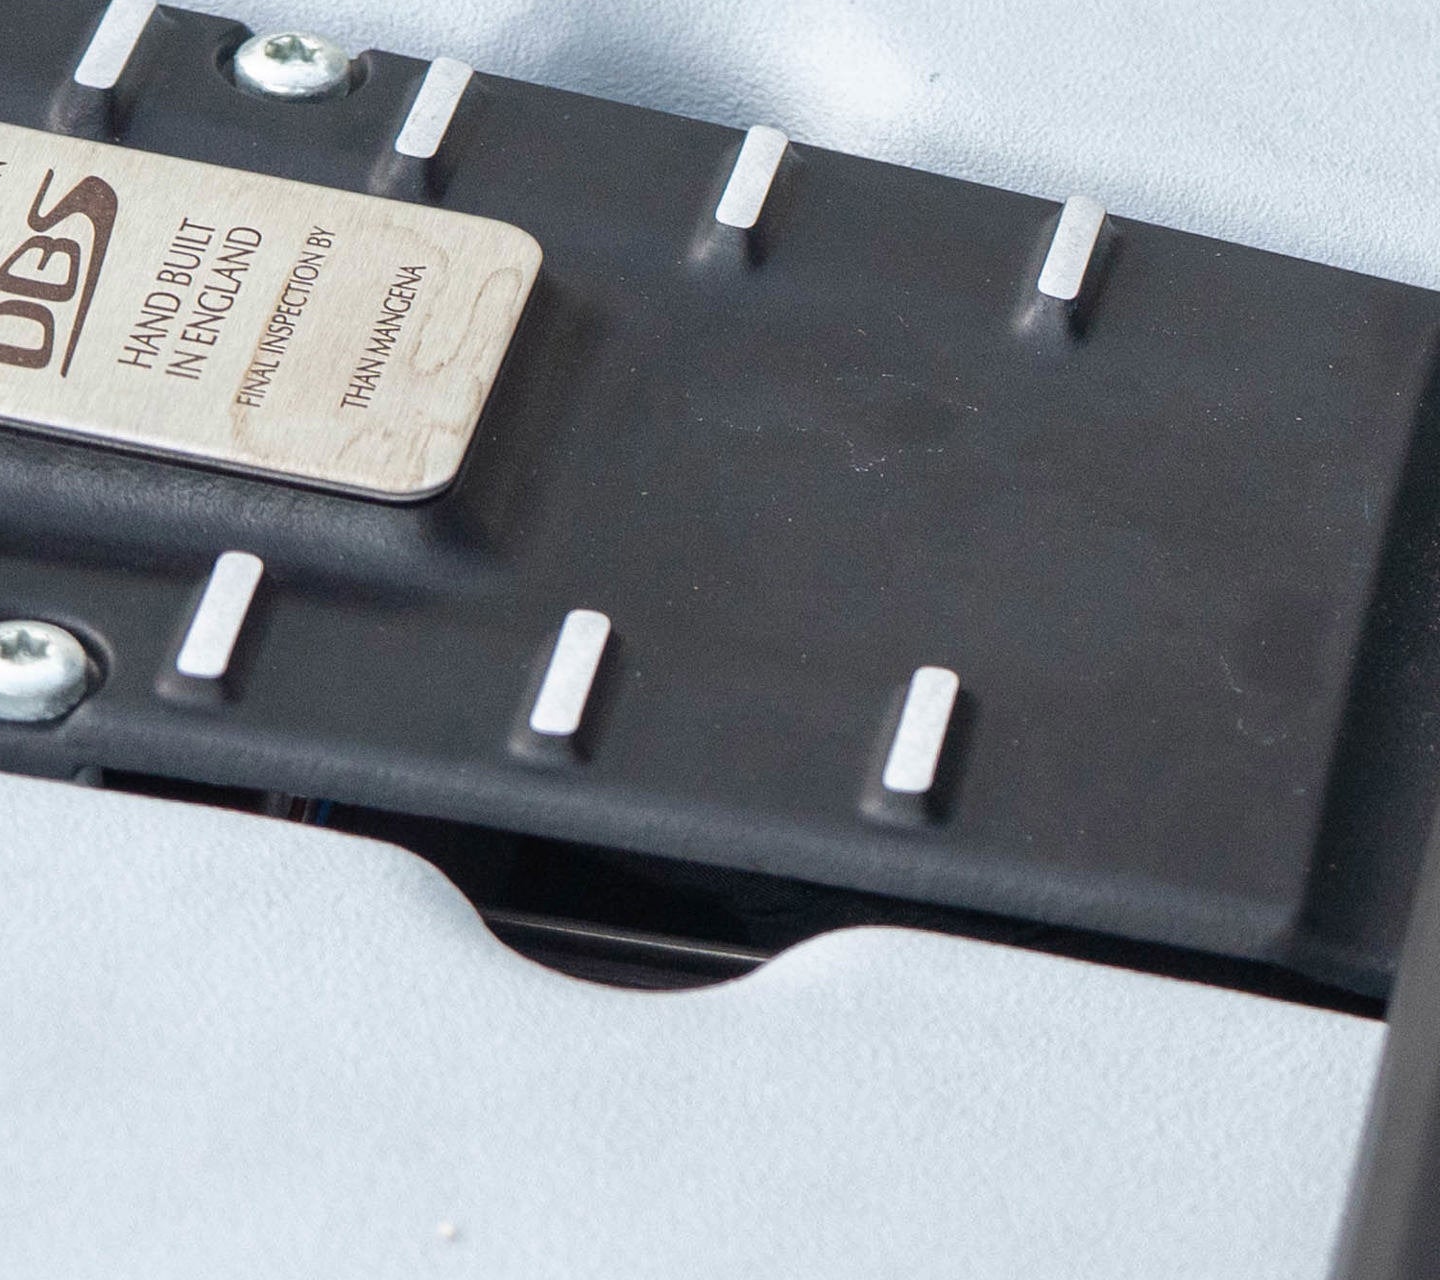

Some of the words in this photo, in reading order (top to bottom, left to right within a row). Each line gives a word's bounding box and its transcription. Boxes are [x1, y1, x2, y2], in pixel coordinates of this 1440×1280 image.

[117, 291, 181, 369] HAND
[156, 217, 216, 287] BUILT
[180, 226, 263, 346] ENGLAND
[236, 360, 280, 408] FINAL
[259, 250, 326, 355] INSPECTION
[306, 225, 336, 249] BY
[340, 357, 386, 409] THAN
[366, 265, 427, 357] MANGENA
[165, 350, 208, 380] IN
